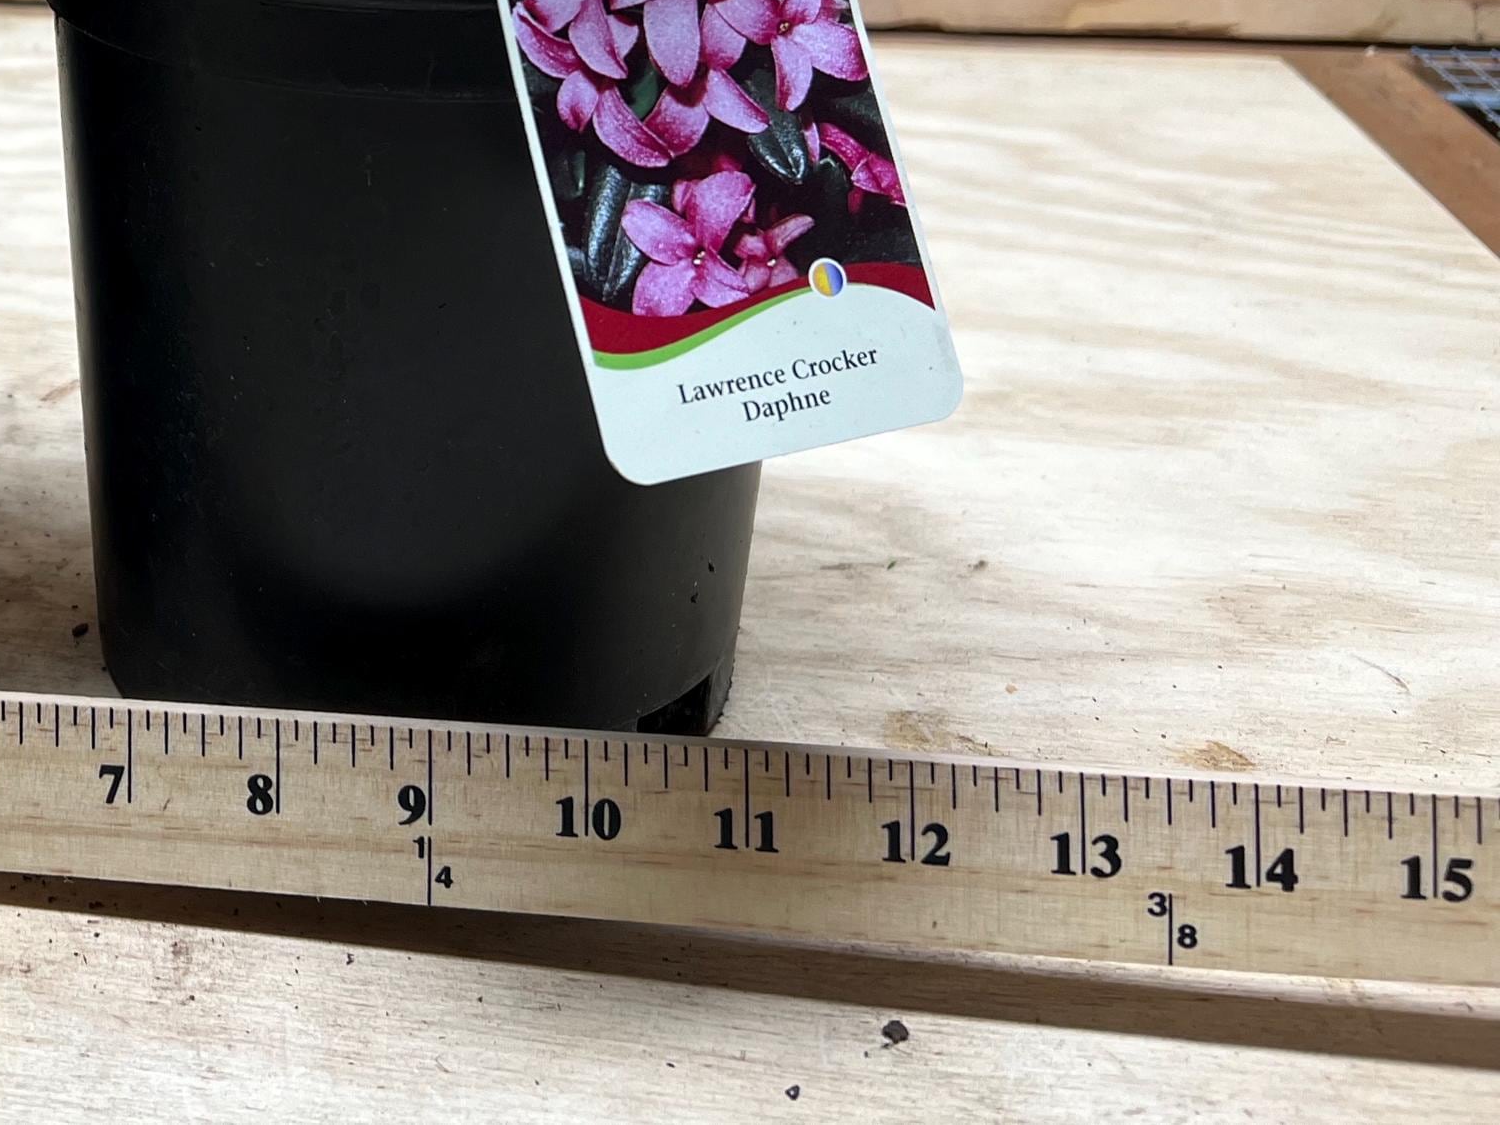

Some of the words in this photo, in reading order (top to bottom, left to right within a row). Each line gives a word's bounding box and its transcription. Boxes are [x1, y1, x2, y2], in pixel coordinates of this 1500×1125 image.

[677, 368, 786, 404] Lawrence
[791, 348, 877, 380] Crocker
[742, 389, 831, 422] Daphne
[99, 764, 125, 804] 7
[246, 773, 274, 816] 8
[397, 784, 426, 825] 9
[555, 795, 622, 841] 10
[713, 807, 780, 854] 11
[881, 819, 952, 867] 12
[1050, 831, 1123, 879] 13
[1224, 844, 1299, 893] 14
[1400, 856, 1474, 903] 15
